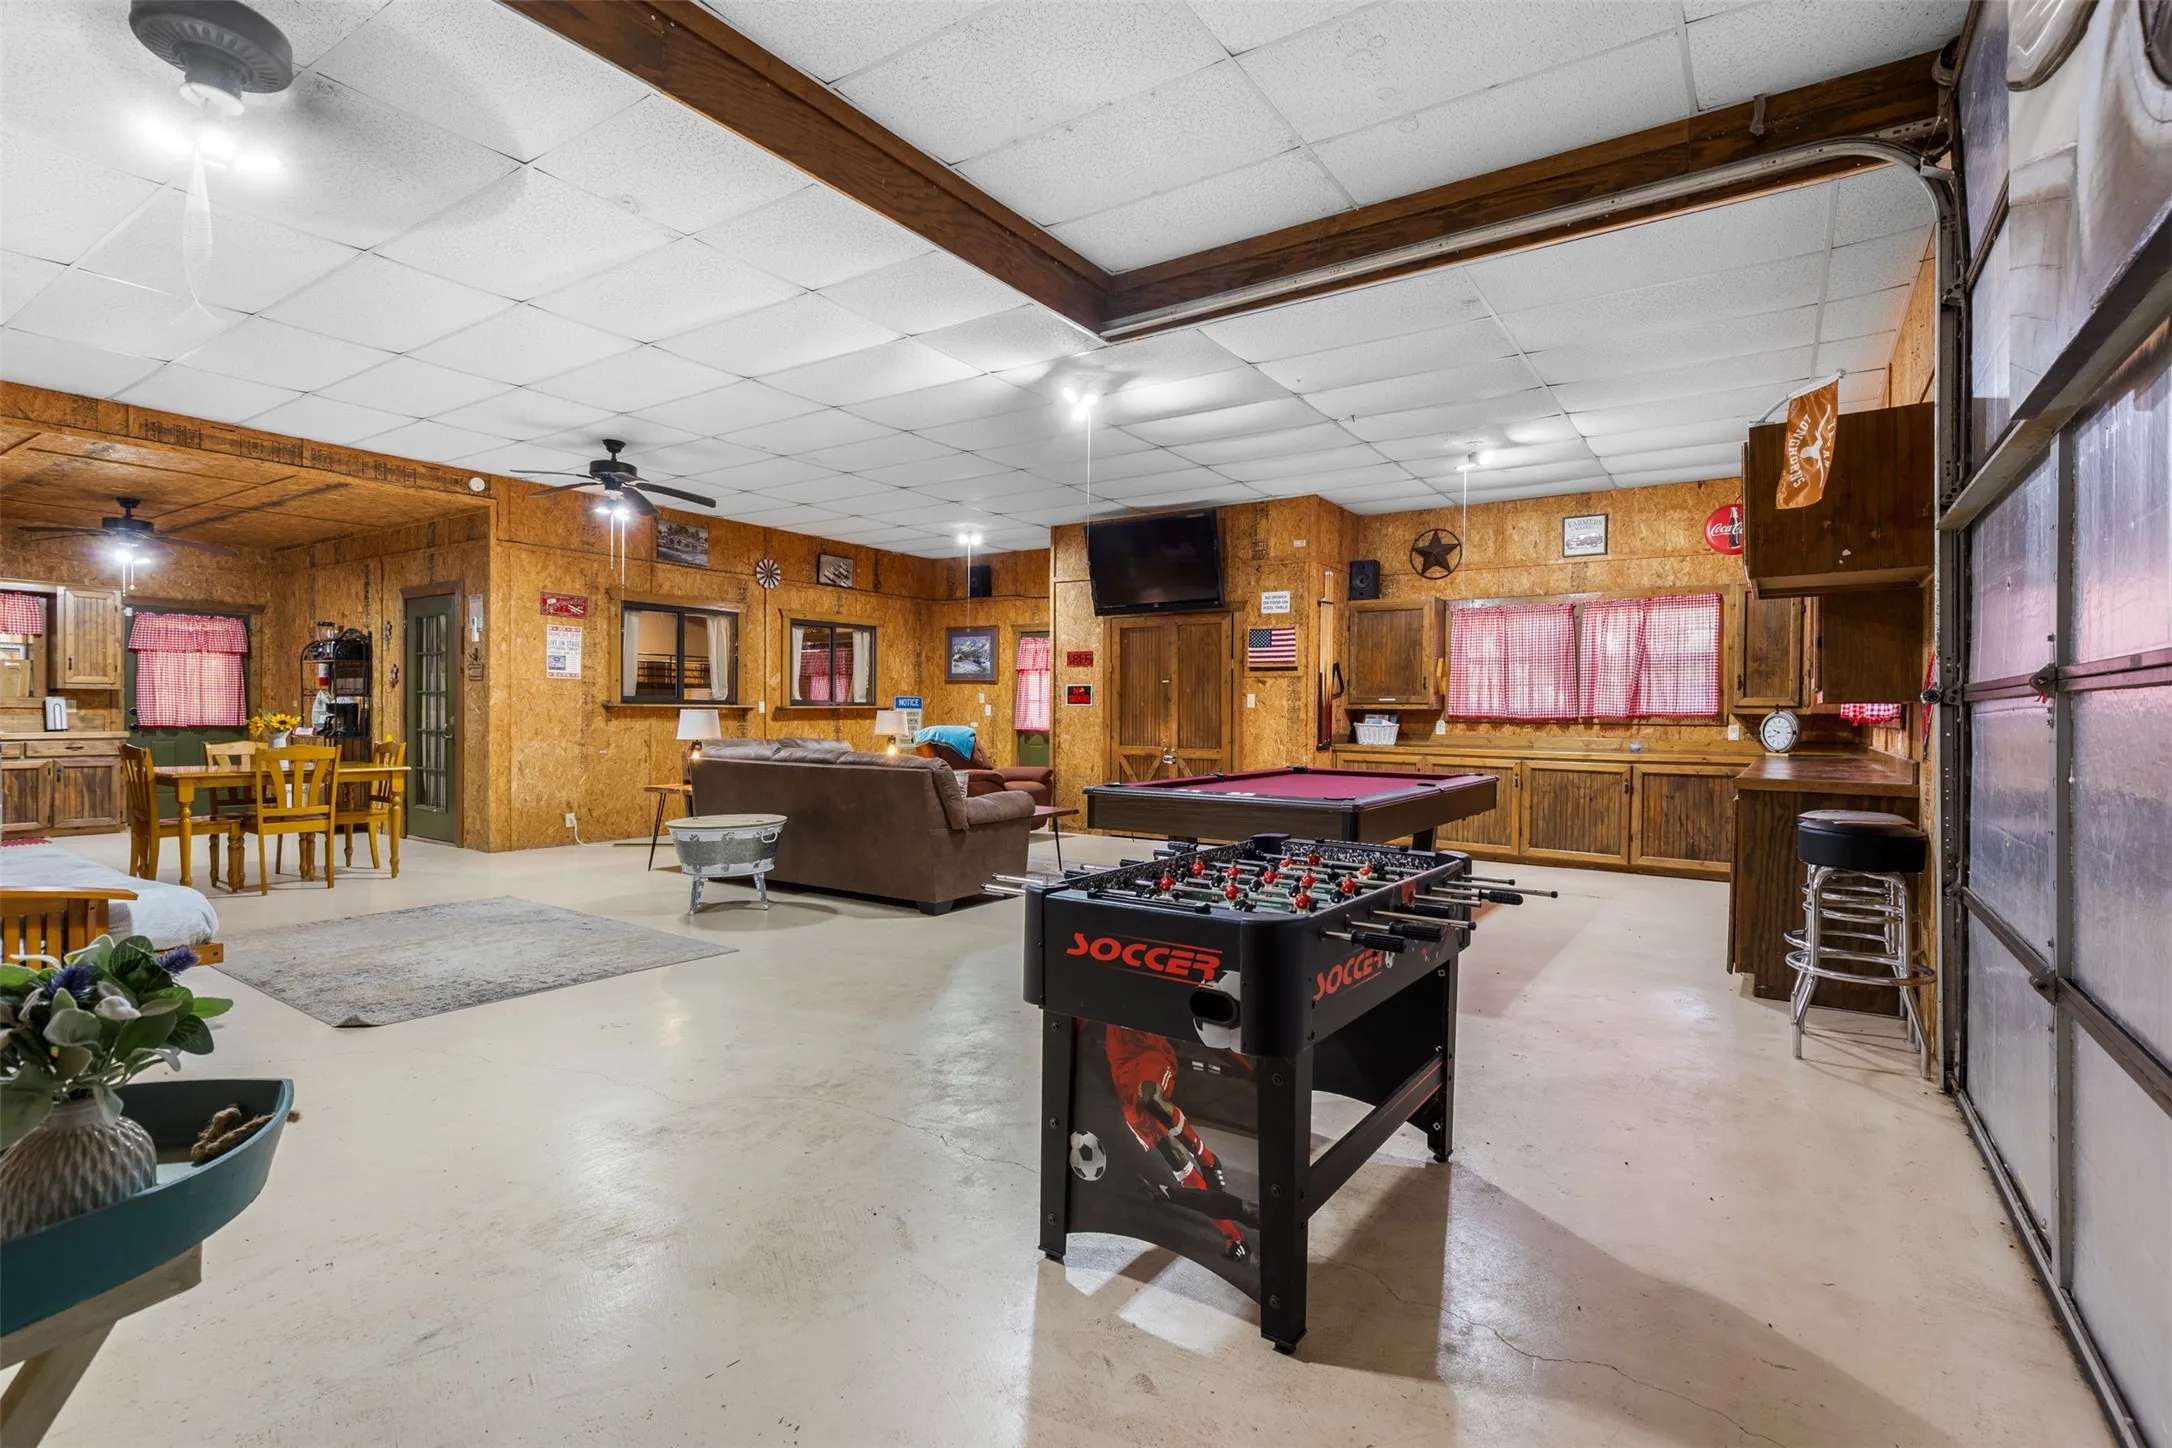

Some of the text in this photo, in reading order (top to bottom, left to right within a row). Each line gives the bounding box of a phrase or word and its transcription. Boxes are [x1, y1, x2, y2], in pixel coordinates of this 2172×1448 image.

[1788, 414, 1811, 488] LONGHORNS
[1567, 519, 1604, 528] FARMERS
[898, 698, 919, 706] NOTICE
[1066, 932, 1221, 981] SOCCER
